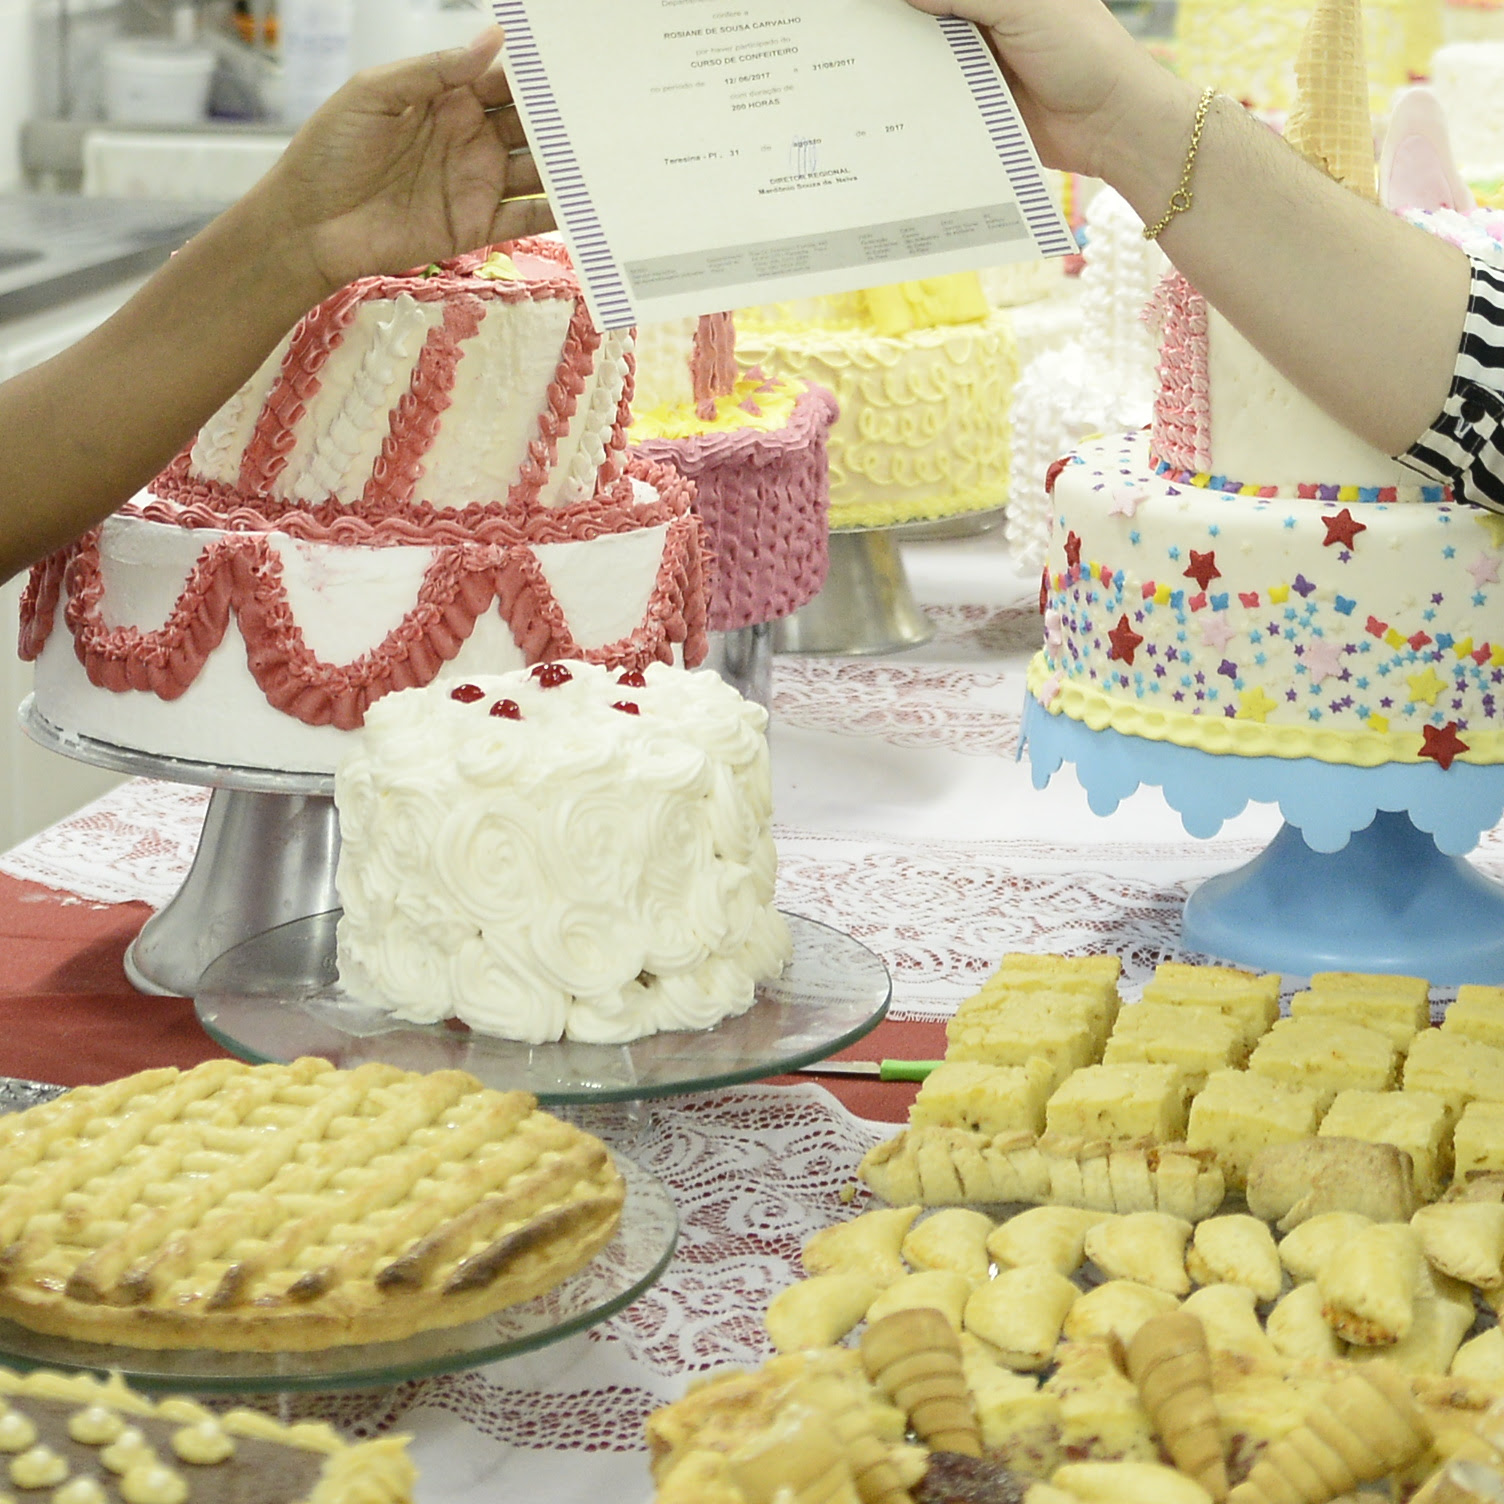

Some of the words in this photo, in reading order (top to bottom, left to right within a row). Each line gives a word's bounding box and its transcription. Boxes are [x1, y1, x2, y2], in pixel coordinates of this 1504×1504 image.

[664, 29, 703, 39] ROSIANE
[705, 27, 718, 35] DE
[720, 24, 750, 33] SOUSA
[752, 17, 801, 29] CARVALHO
[690, 58, 722, 68] CURSO
[724, 57, 736, 65] DE
[738, 47, 799, 62] CONFEITEIRO
[748, 98, 781, 109] HORAS
[664, 154, 701, 165] Teresina
